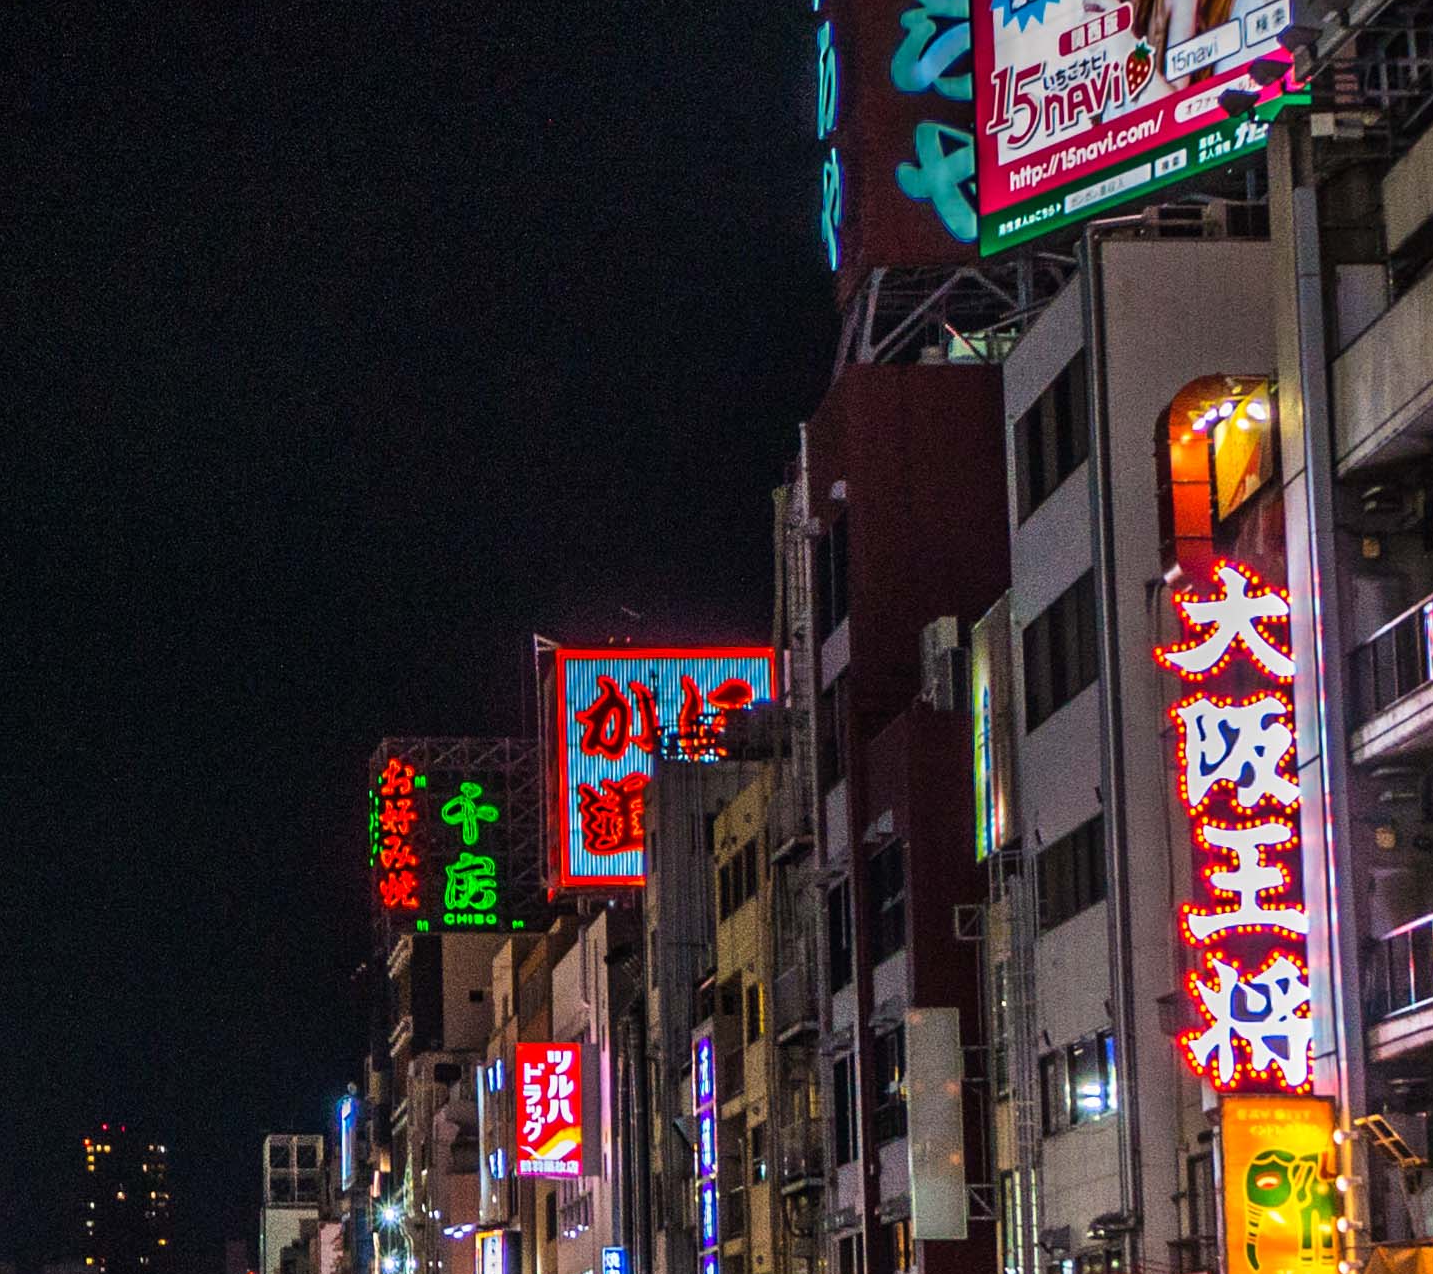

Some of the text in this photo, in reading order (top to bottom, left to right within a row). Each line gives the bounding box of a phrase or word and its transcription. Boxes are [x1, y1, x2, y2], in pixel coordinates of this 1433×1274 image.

[1008, 109, 1165, 193] http://15navi.com/
[379, 756, 421, 911] お好み焼
[440, 780, 501, 912] 千房
[1162, 563, 1315, 1089] 大阪王将
[443, 912, 498, 927] CHIBO
[520, 1061, 547, 1144] ドラッグ
[546, 1048, 575, 1125] ツルハ
